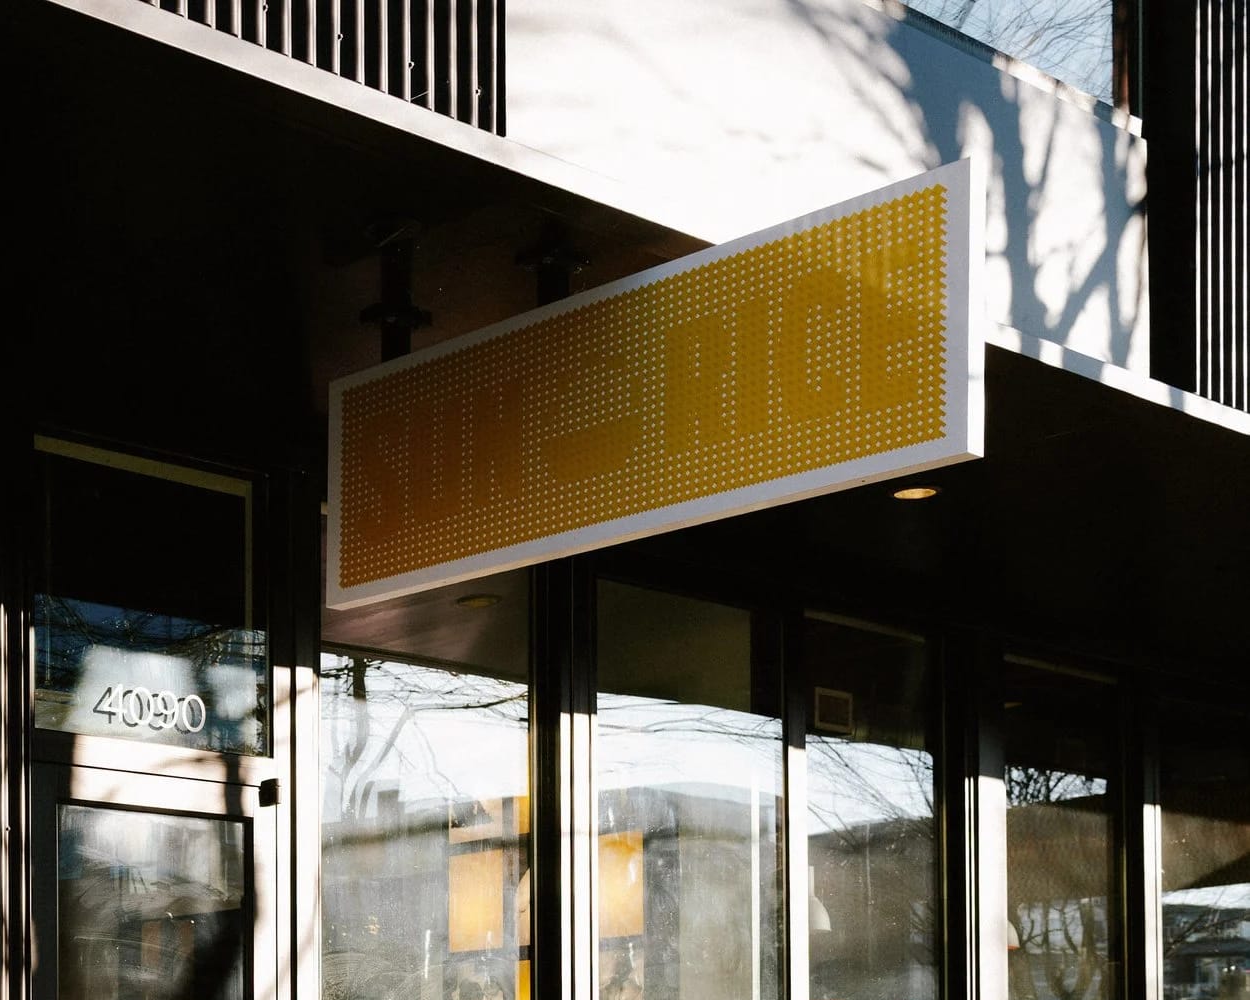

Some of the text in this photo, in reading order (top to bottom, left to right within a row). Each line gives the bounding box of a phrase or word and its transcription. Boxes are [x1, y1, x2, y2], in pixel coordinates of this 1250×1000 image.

[354, 242, 920, 545] SUN RICE
[100, 684, 206, 733] 4090
